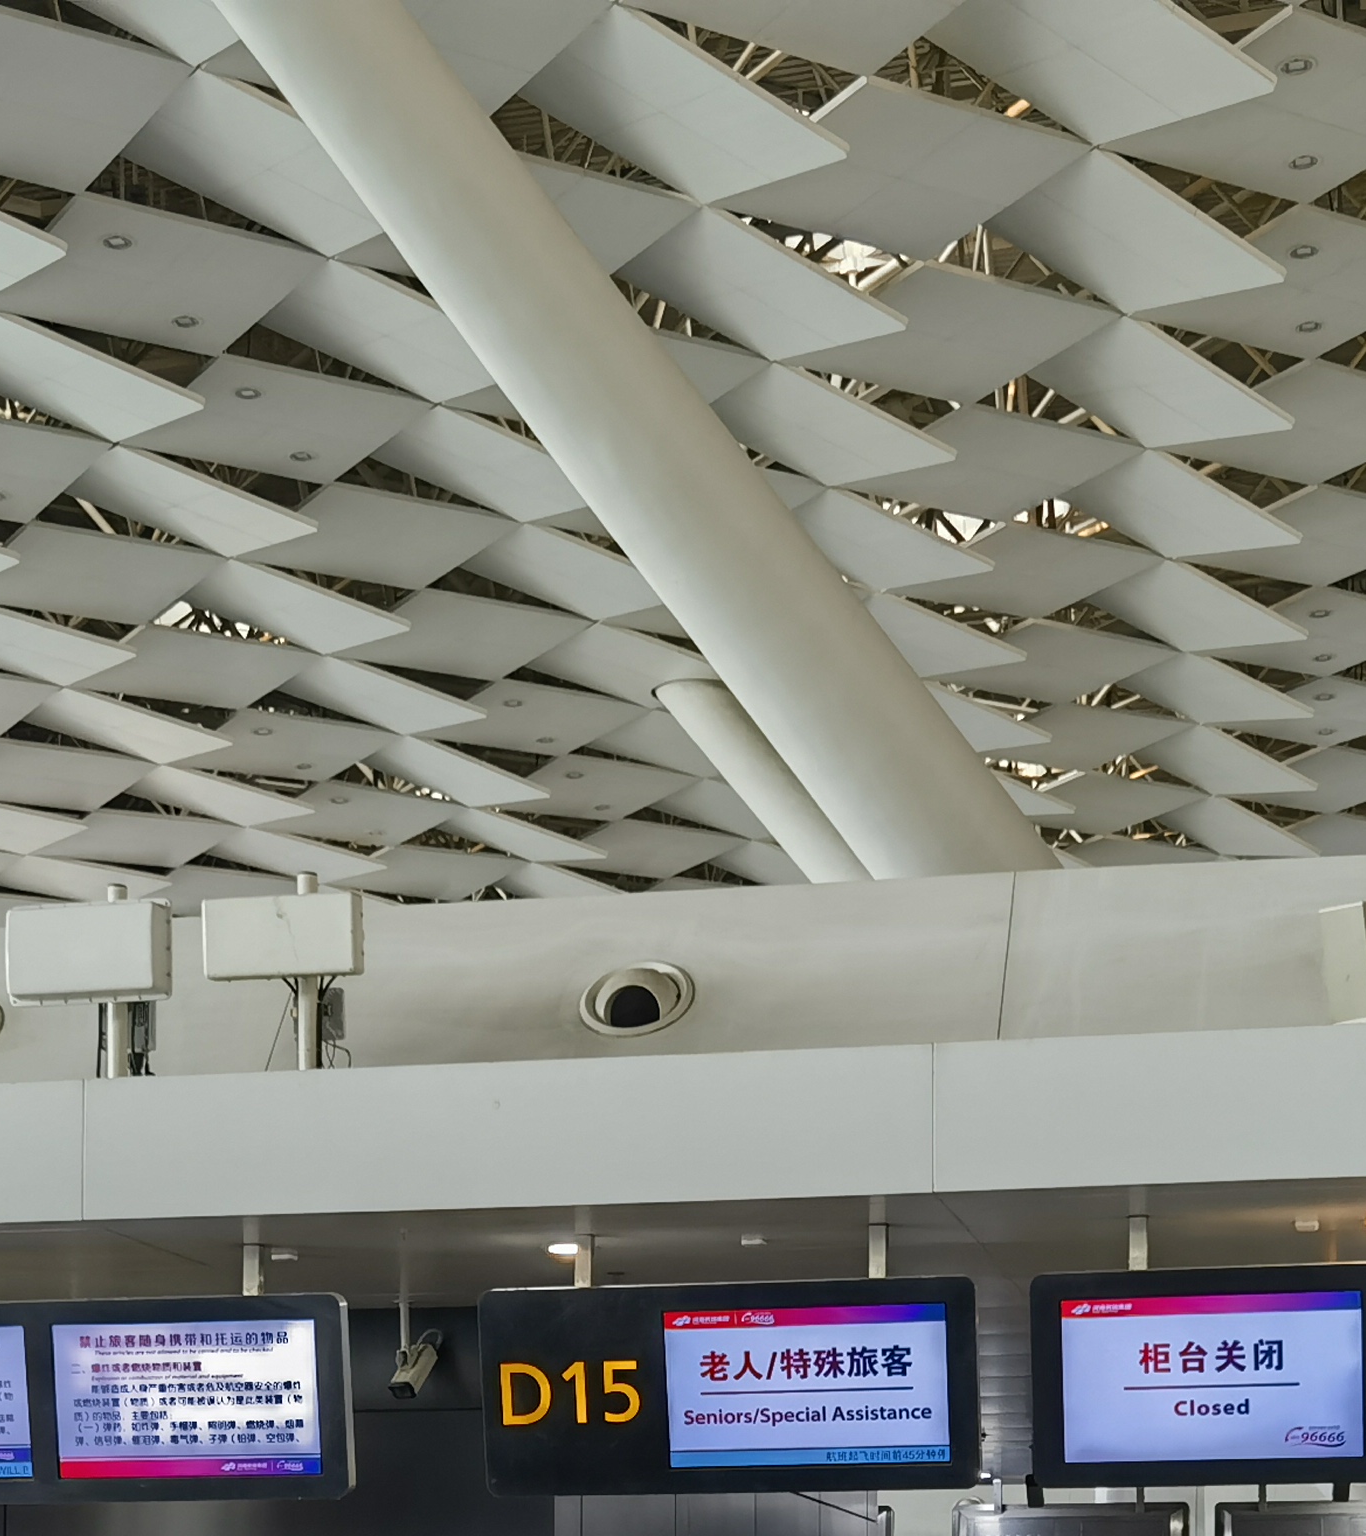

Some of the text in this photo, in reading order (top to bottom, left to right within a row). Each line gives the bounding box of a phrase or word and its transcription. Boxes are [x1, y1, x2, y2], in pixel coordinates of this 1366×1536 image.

[79, 1331, 289, 1348] 禁止旅客随身携带和托运的物品
[699, 1345, 913, 1381] 老人/特殊旅客
[1138, 1339, 1285, 1375] 柜台关闭
[498, 1359, 642, 1426] D15
[683, 1404, 933, 1427] Seniors/Special Assistance
[1173, 1399, 1250, 1417] Closed
[1301, 1431, 1345, 1443] 96666
